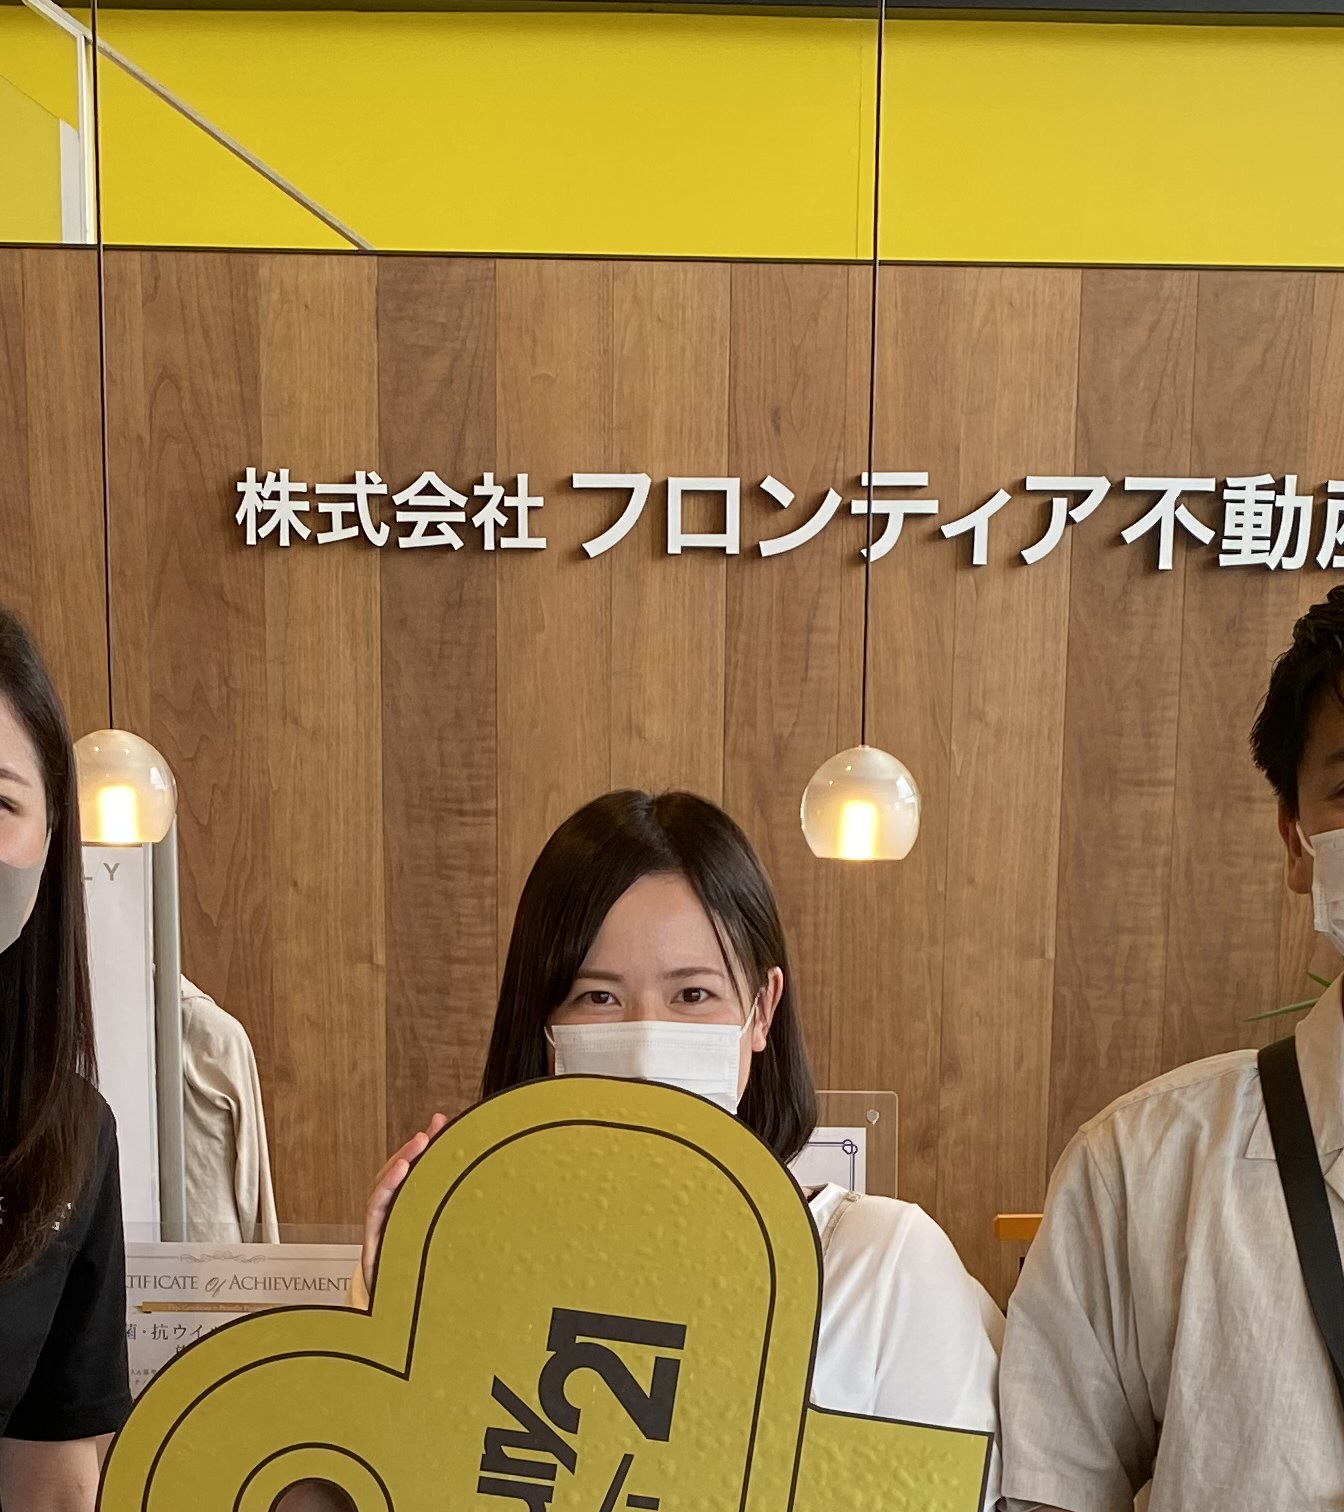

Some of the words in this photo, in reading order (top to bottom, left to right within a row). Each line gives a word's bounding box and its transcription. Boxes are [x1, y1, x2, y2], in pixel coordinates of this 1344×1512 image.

[235, 466, 547, 551] 株式会社
[126, 1274, 198, 1290] TIFICATE
[228, 1274, 352, 1292] ACHIEVEMENT
